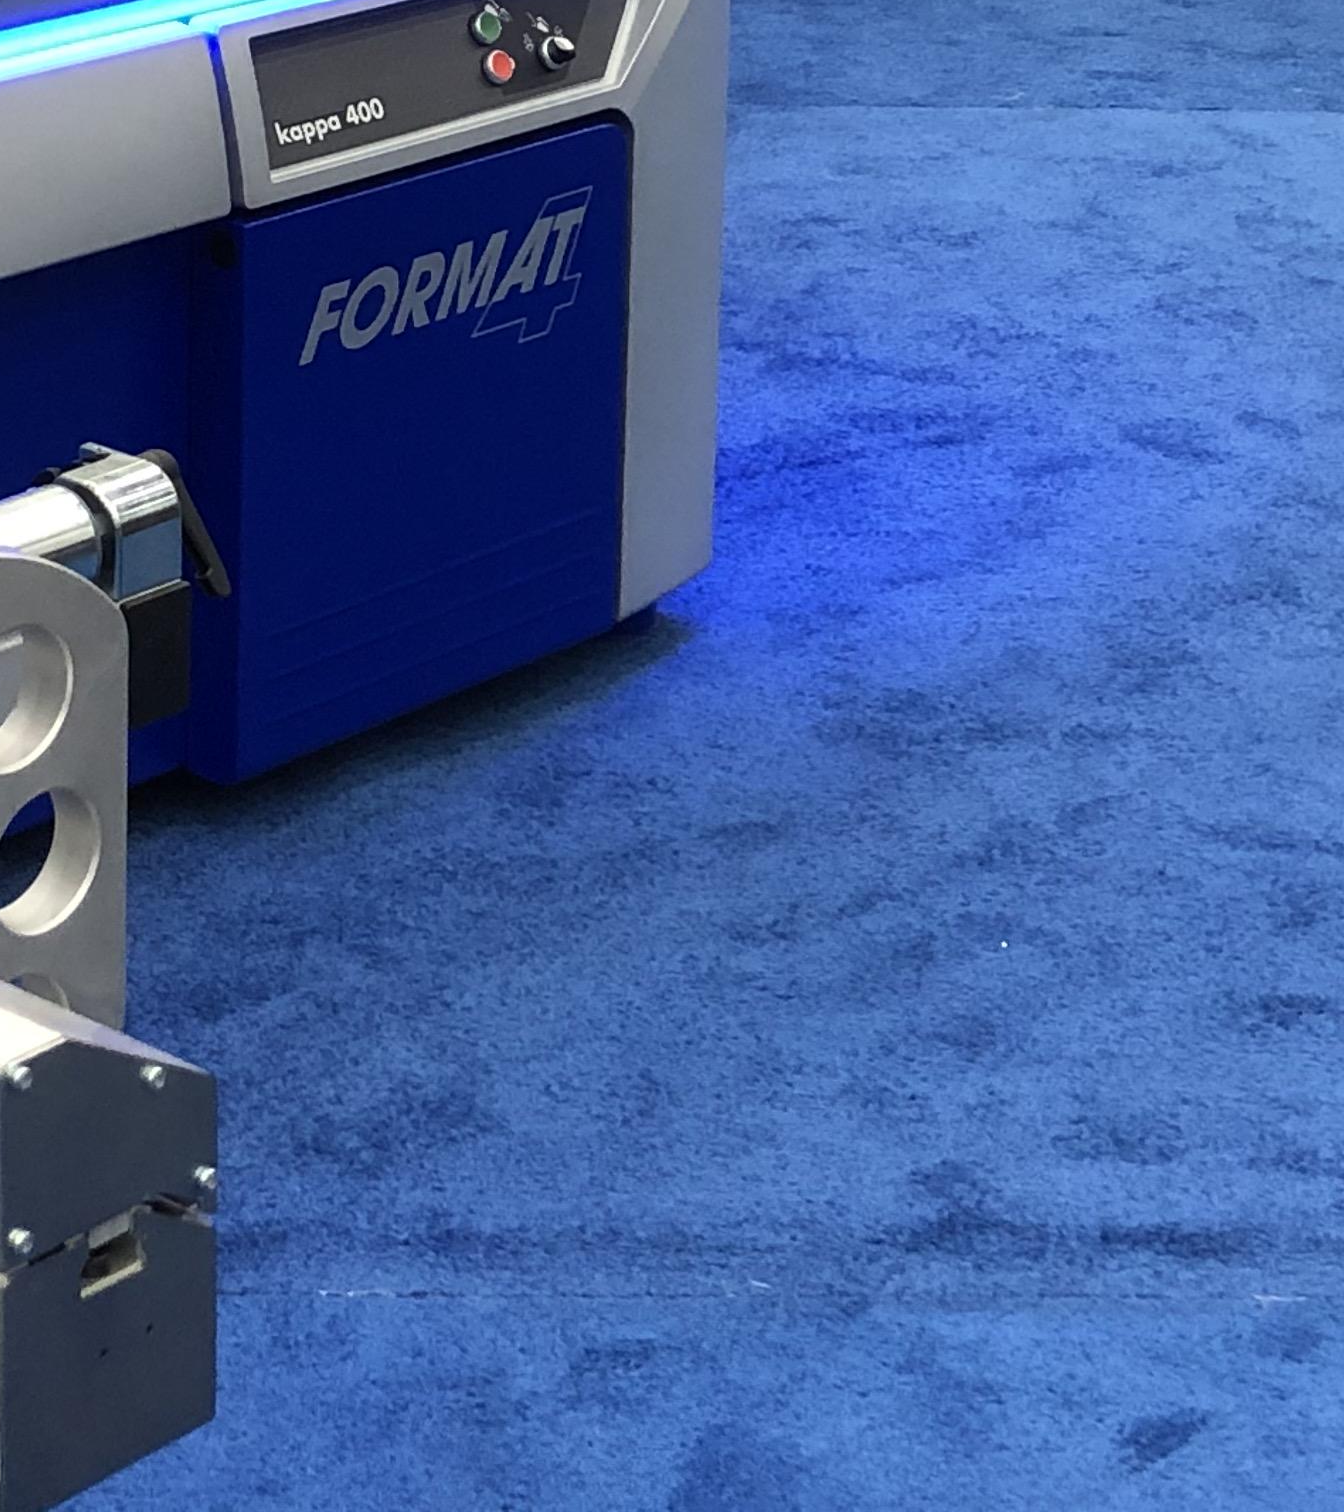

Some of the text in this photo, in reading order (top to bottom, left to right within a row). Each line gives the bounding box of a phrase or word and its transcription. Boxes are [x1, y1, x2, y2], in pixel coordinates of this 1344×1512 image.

[274, 97, 385, 145] kappa 400
[298, 205, 585, 367] FORMAT
